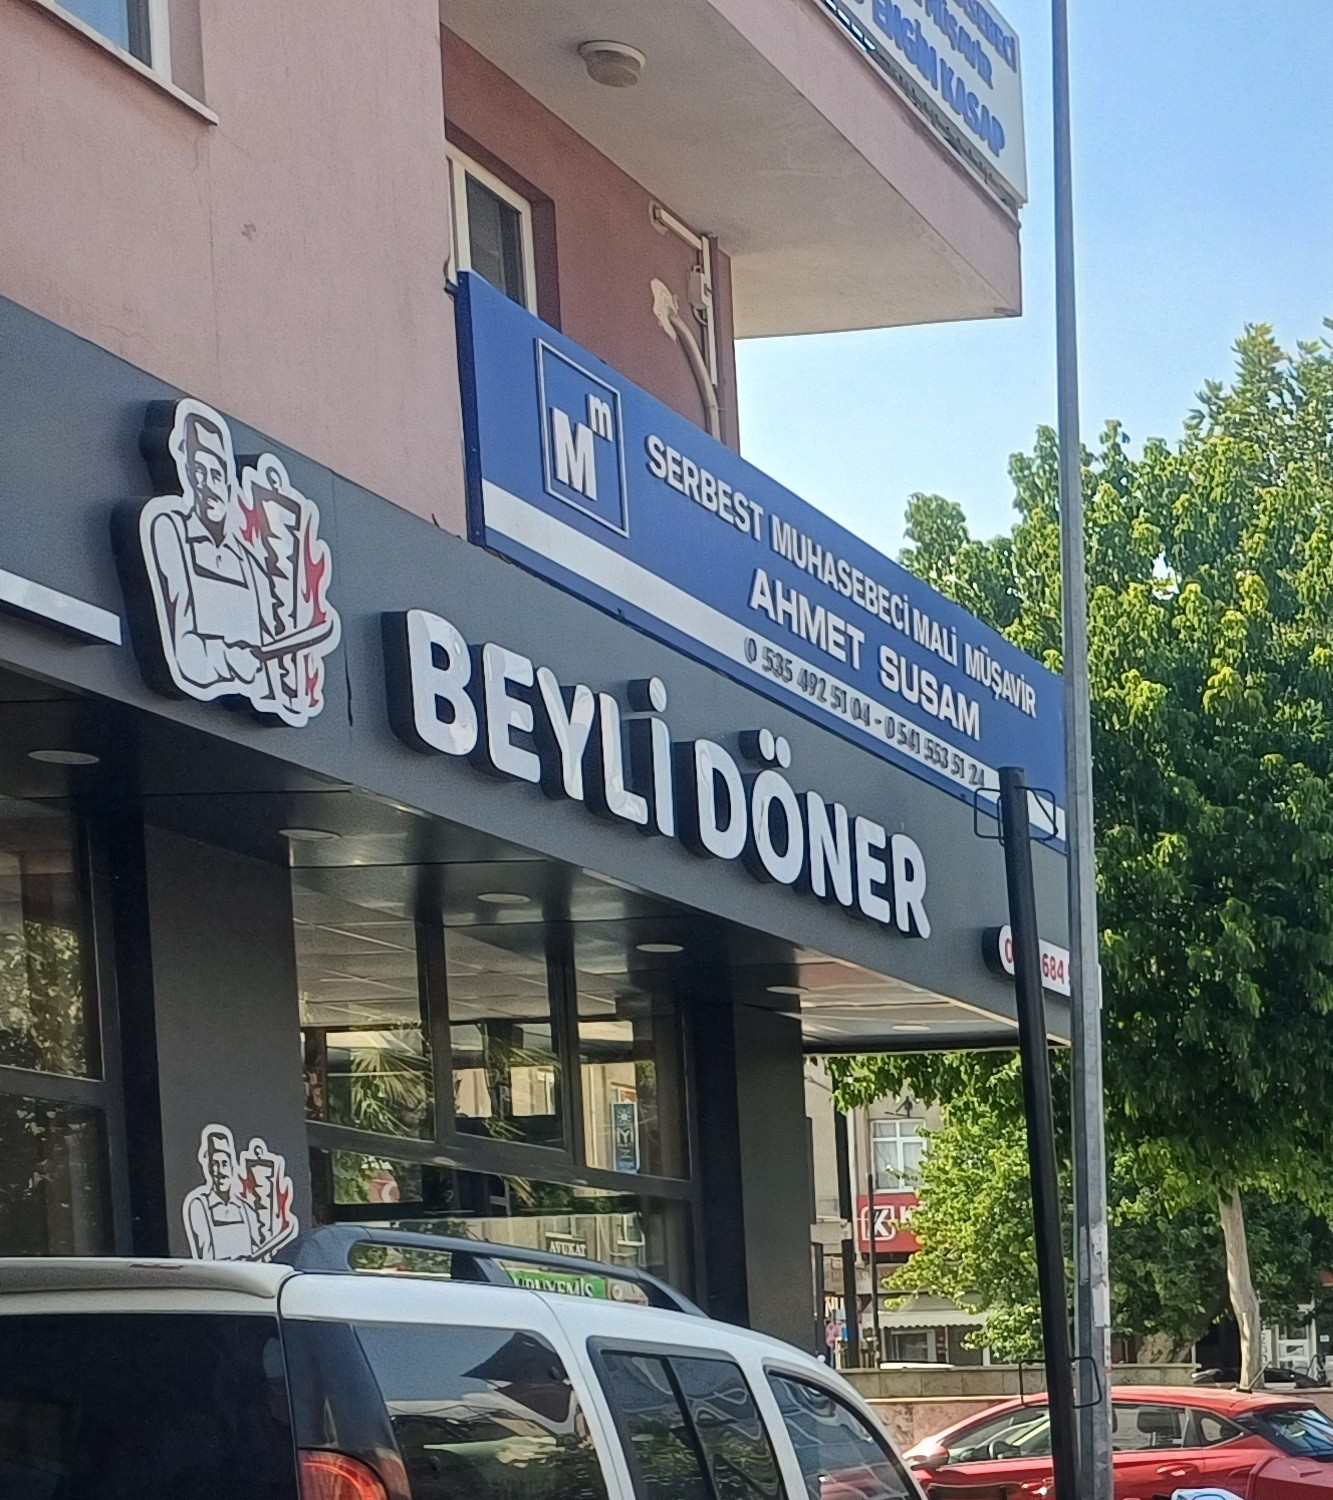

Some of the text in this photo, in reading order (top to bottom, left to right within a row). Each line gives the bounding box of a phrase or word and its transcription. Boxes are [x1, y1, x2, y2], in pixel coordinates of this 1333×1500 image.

[940, 57, 1005, 158] KASAP
[645, 433, 1037, 719] SERBEST MUHASEBECİ MALİ MÜŞAVİR
[749, 567, 981, 741] AHMET SUSAM
[406, 608, 931, 940] BEYLİ DÖNER
[744, 637, 757, 664] 0
[762, 646, 793, 684] 535
[797, 667, 827, 703] 492
[830, 683, 847, 714] 51
[851, 697, 870, 727] 04
[885, 716, 896, 740] 0
[897, 724, 921, 755] 541
[923, 738, 950, 769] 553
[950, 753, 966, 780] 51
[968, 763, 987, 788] 24
